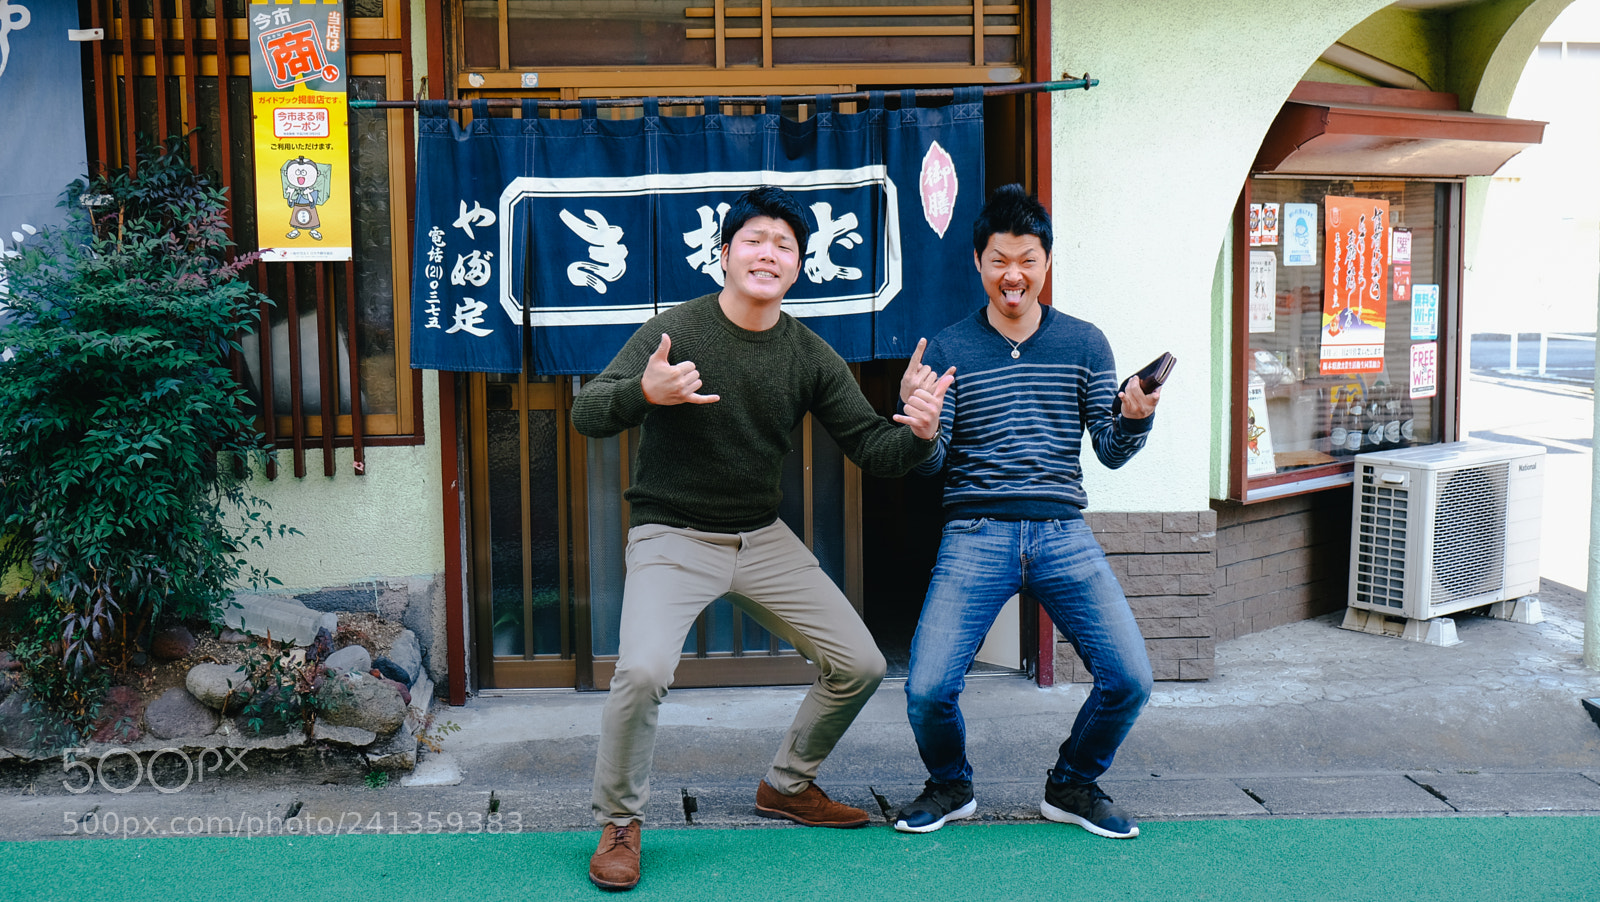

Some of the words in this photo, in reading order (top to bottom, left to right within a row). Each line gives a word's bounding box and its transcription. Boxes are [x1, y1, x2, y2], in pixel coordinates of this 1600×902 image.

[253, 7, 291, 30] 今市
[326, 11, 341, 52] 当店は
[277, 111, 325, 121] 今市まる得
[283, 122, 320, 131] クーポン
[924, 160, 951, 217] 御膳
[1414, 307, 1435, 322] Wi-Fi
[1413, 349, 1434, 368] FREE
[1413, 368, 1434, 386] Wi-Fi
[1518, 462, 1537, 472] National
